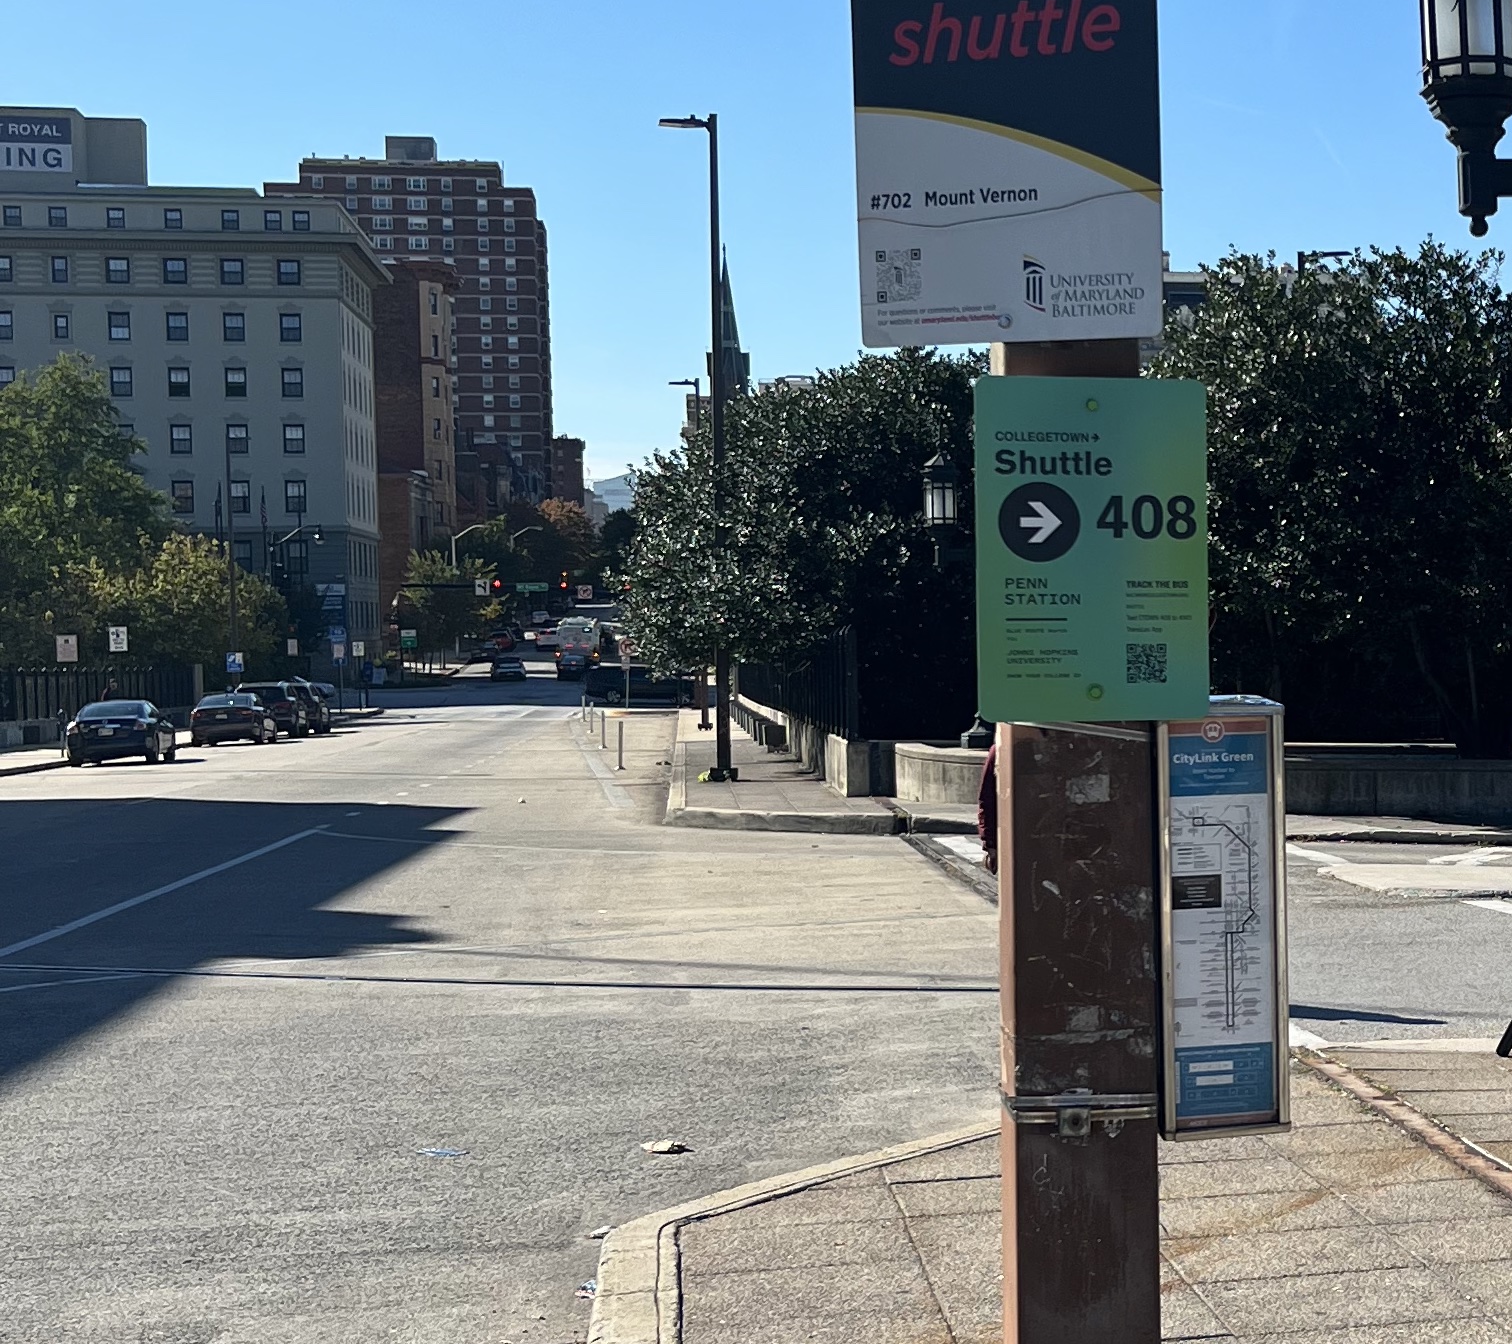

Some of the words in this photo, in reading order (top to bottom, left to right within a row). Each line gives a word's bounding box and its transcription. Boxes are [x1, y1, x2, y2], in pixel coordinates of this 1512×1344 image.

[8, 123, 62, 137] ROYAL
[5, 146, 63, 169] ING
[870, 192, 913, 211] #702
[924, 188, 976, 208] Mount
[979, 185, 1039, 205] Vernon
[1049, 272, 1135, 288] UNIVERSITY
[1050, 289, 1062, 301] of
[1064, 287, 1145, 303] MARYLAND
[1052, 302, 1136, 318] BALTIMORE
[994, 431, 1091, 444] COLLEGETOWN
[994, 448, 1113, 477] Shuttle
[1096, 494, 1198, 541] 408
[1004, 577, 1048, 590] PENN
[1126, 580, 1154, 589] TRACK
[1155, 580, 1170, 589] THE
[1172, 580, 1189, 589] BUS
[1004, 593, 1082, 605] STATION
[1172, 752, 1220, 766] CityLink
[1220, 752, 1255, 762] Green
